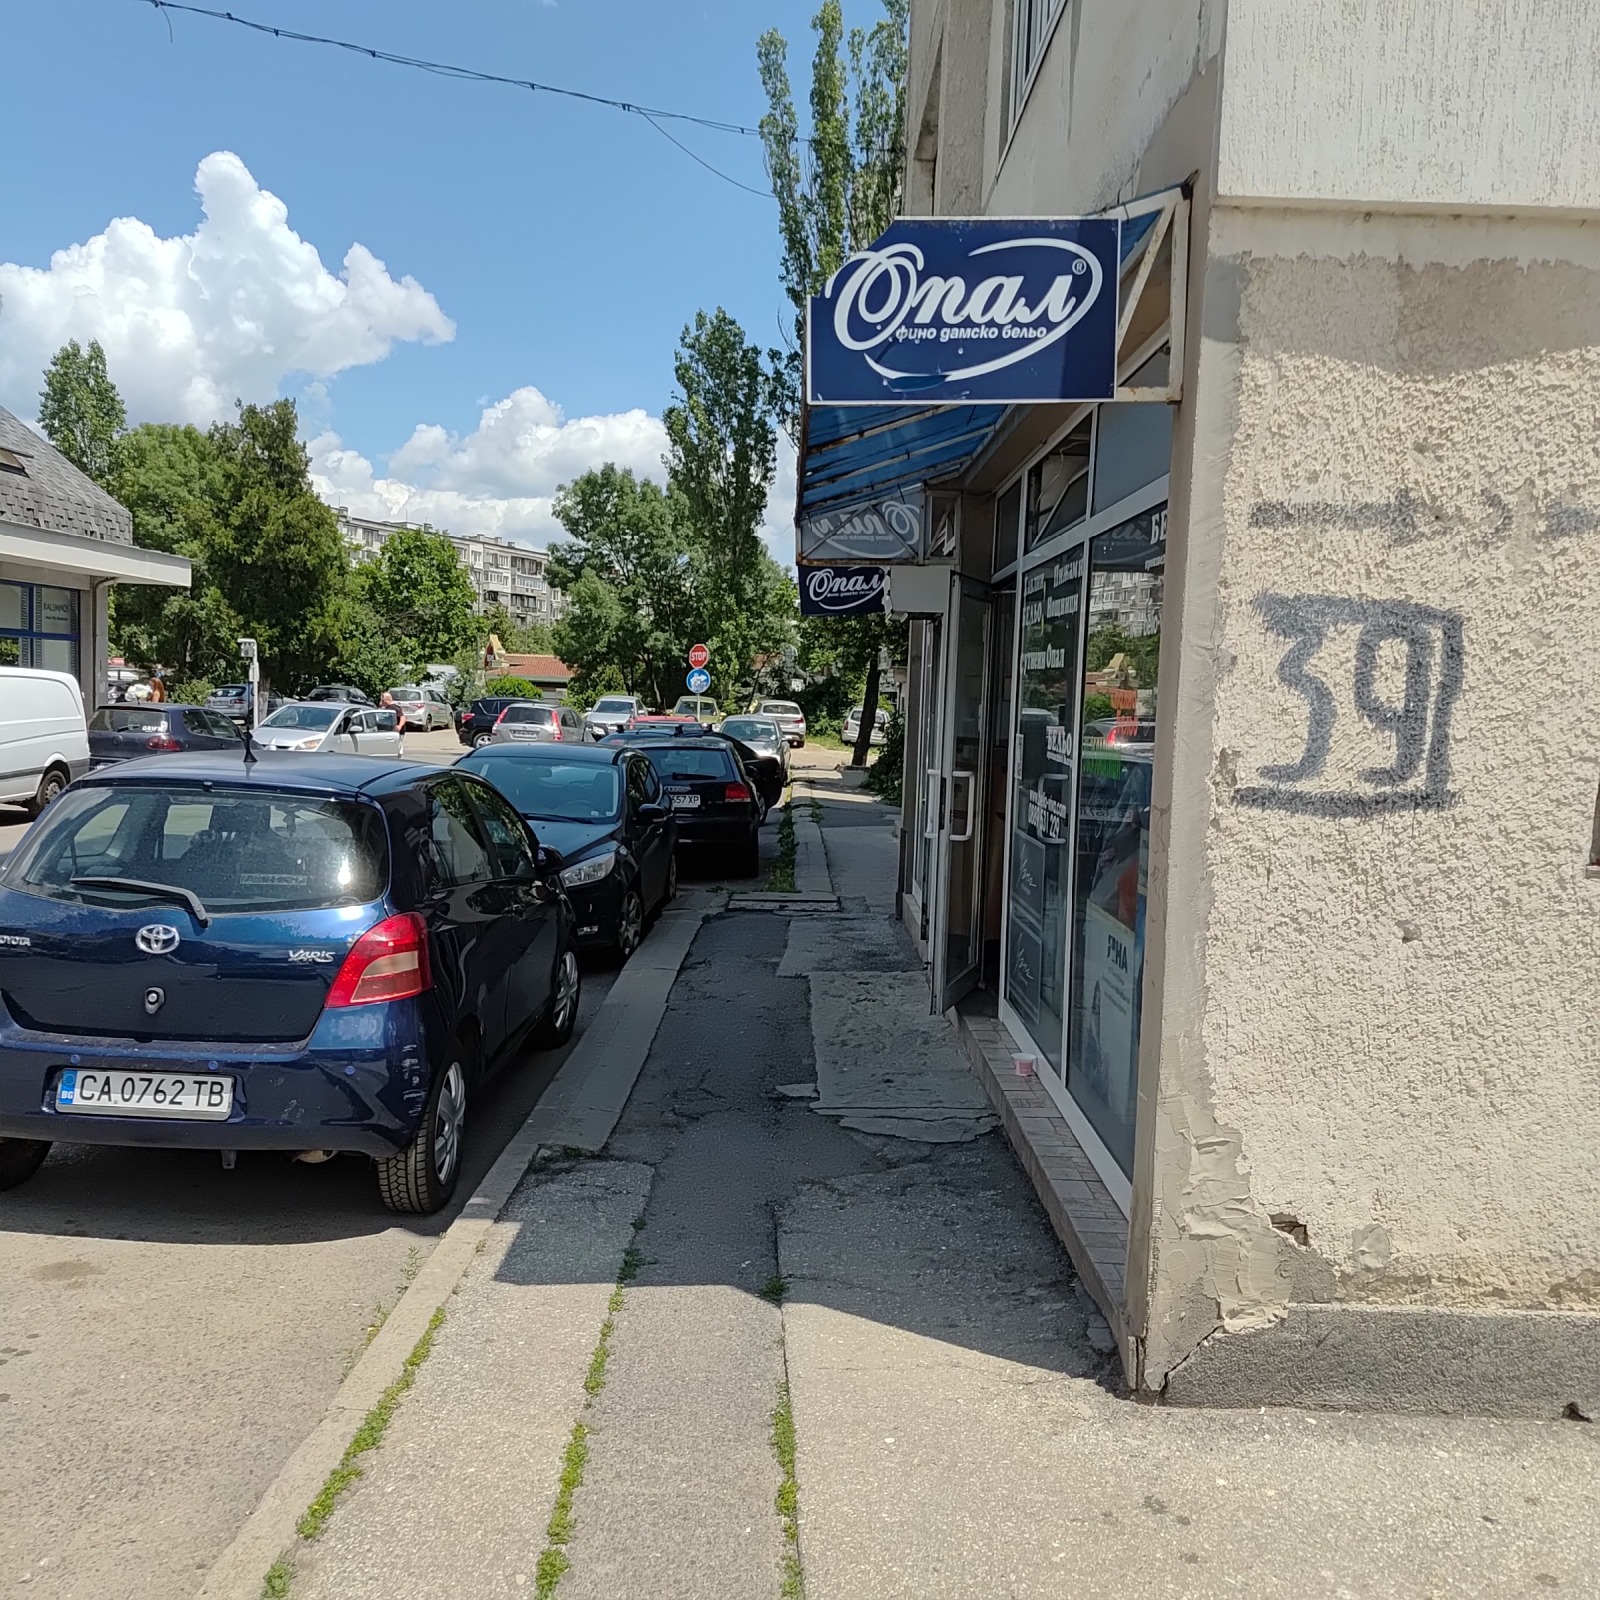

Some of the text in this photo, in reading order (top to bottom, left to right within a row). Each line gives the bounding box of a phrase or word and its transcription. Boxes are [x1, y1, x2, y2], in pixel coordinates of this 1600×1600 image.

[825, 243, 1077, 350] Опал
[895, 324, 1047, 342] фино дамско бельо
[807, 568, 881, 601] Опал
[691, 651, 707, 661] STOP
[1253, 593, 1430, 786] 39
[0, 935, 31, 946] OYOTA
[61, 1090, 74, 1099] BG
[80, 1075, 224, 1107] CA 0762 TB
